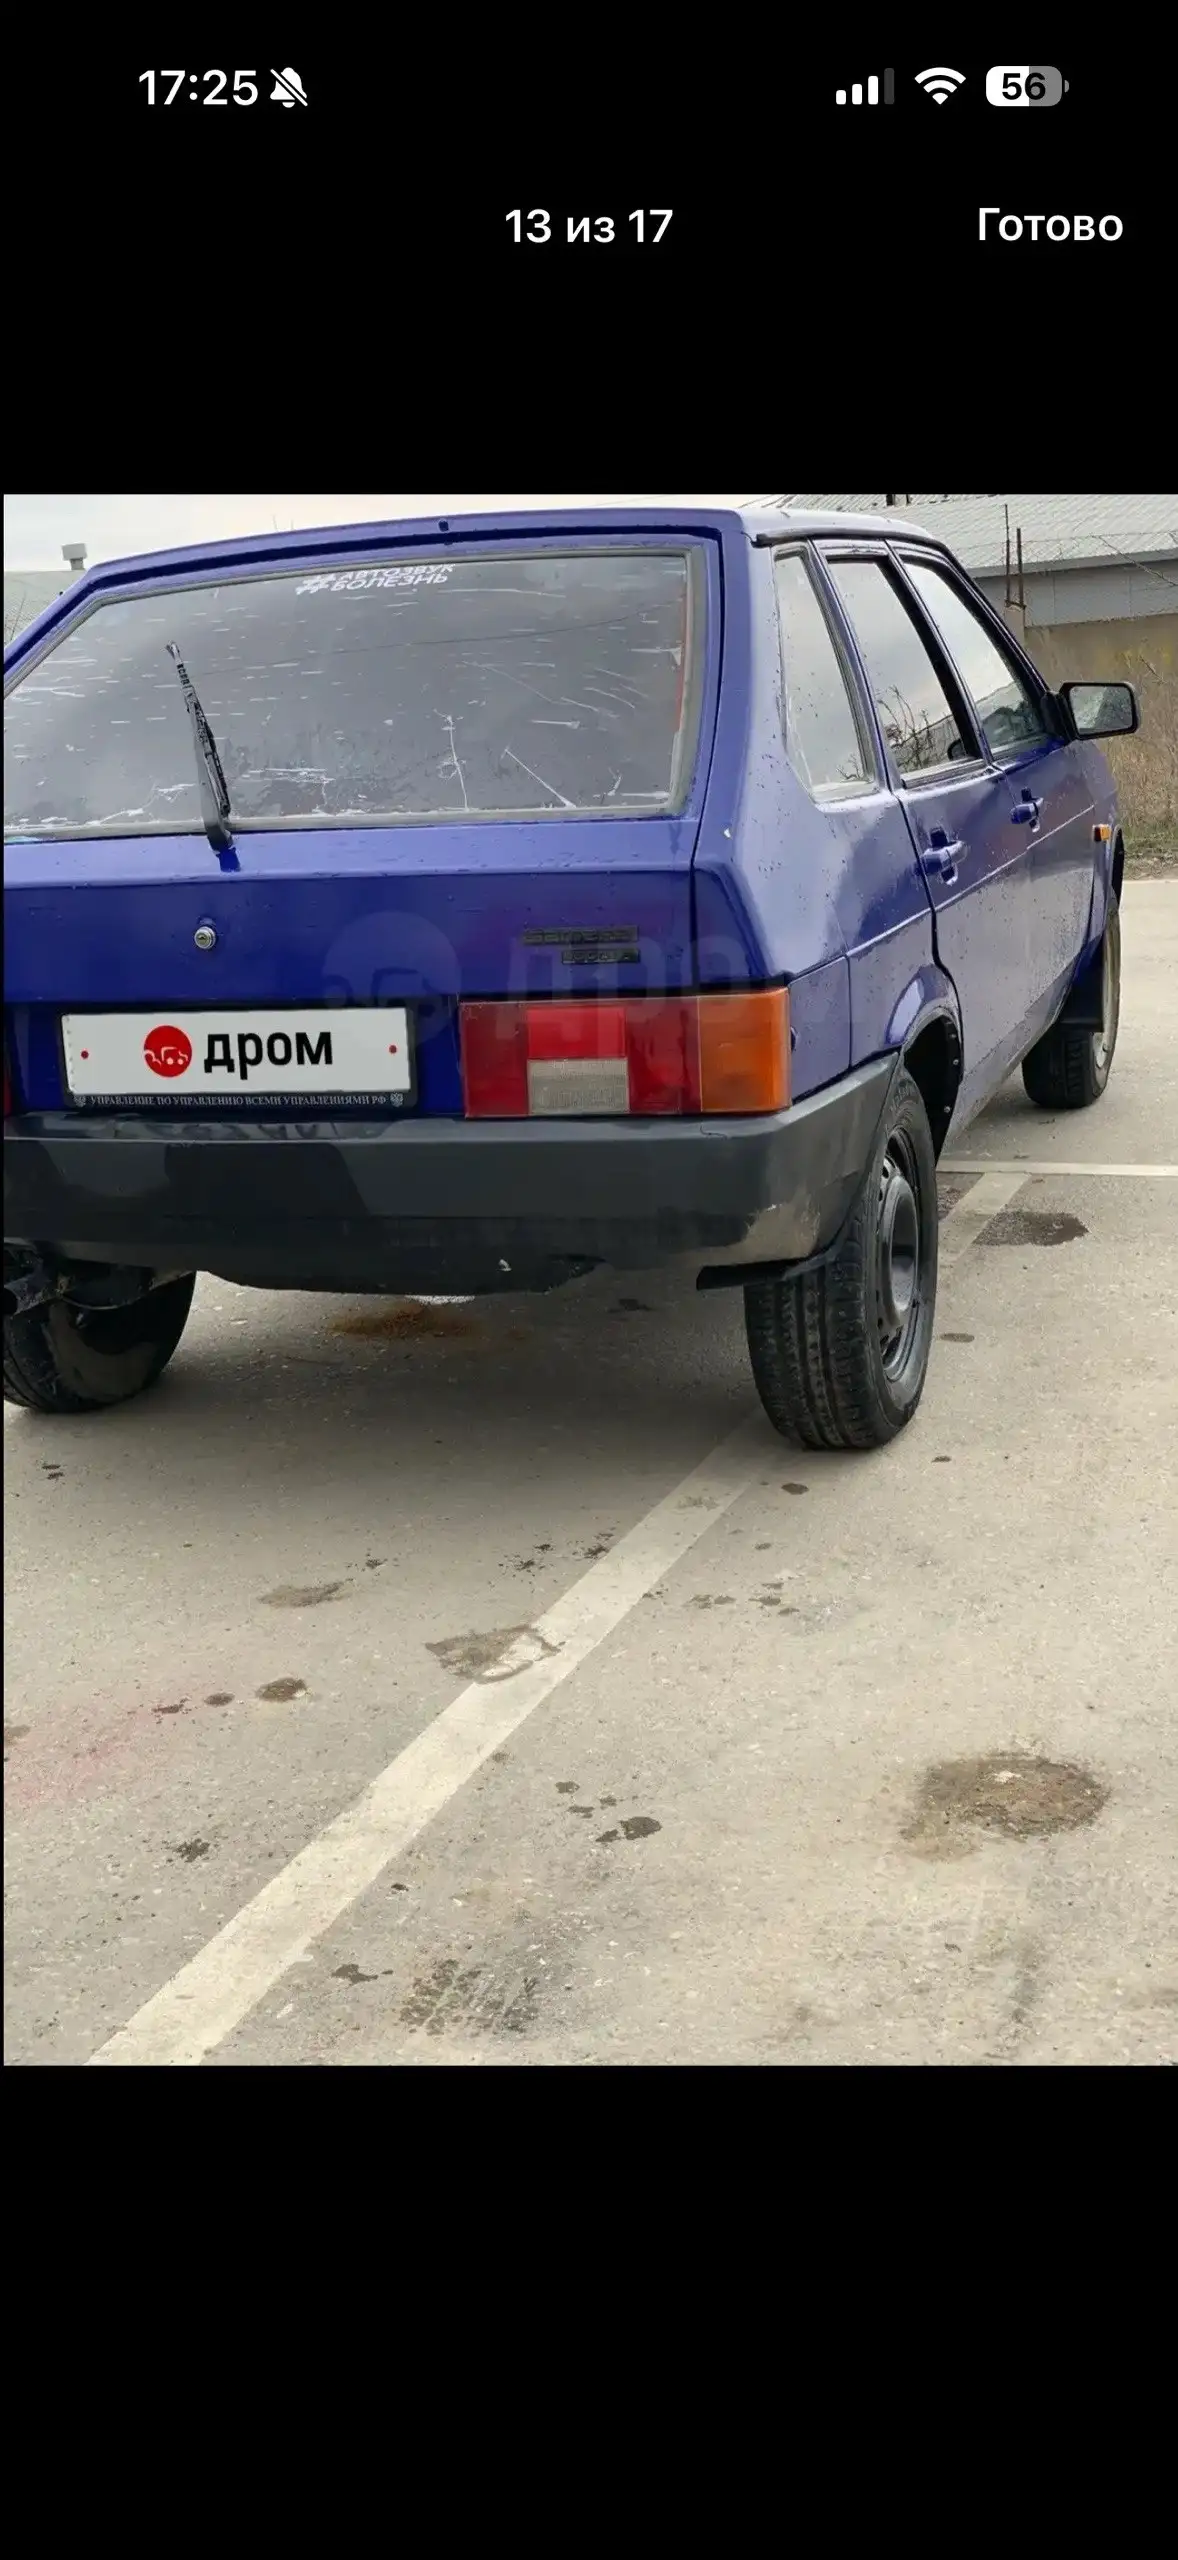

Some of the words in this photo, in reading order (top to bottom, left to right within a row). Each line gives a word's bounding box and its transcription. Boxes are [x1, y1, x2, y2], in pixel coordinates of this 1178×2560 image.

[90, 1095, 155, 1106] УПРАВЛЕНИЕ
[173, 1095, 244, 1106] УПРАВЛЕНИЮ
[245, 1095, 282, 1106] ВСЕМИ
